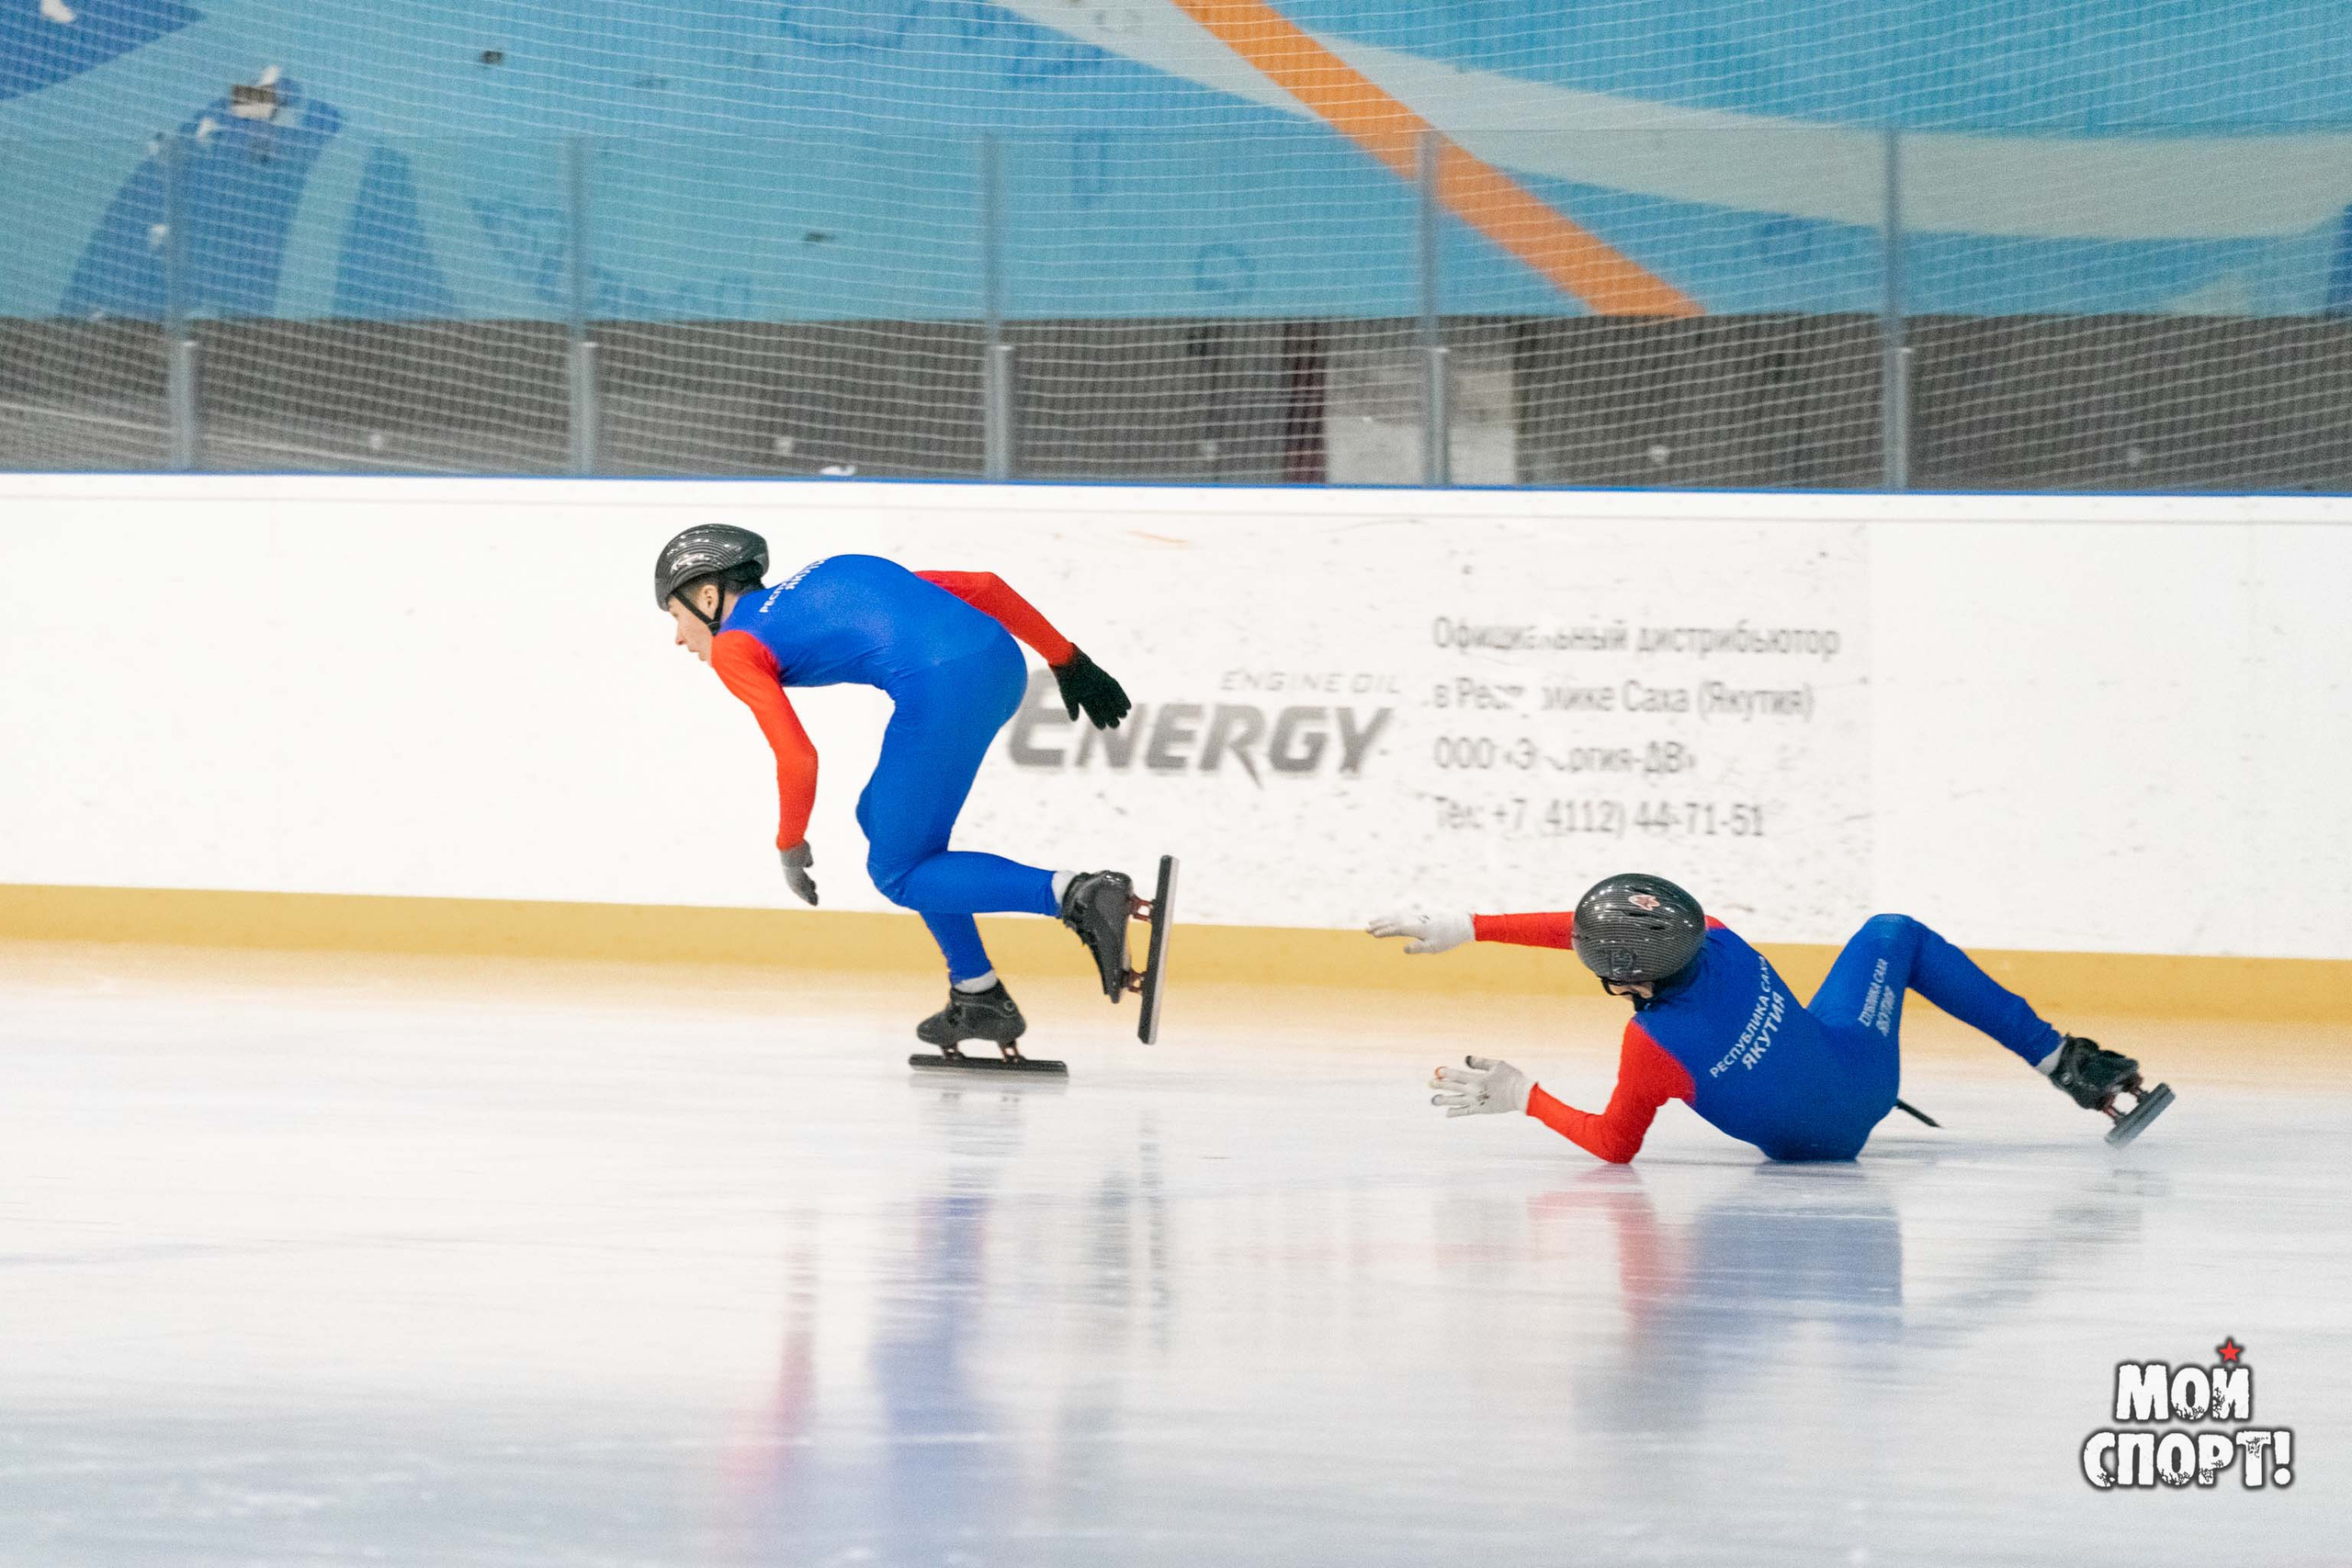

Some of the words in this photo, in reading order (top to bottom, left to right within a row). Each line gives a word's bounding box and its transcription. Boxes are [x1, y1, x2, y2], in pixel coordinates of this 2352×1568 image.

[1637, 619, 1842, 662] дистрибьютор
[1219, 669, 1344, 694] ENGINE
[1350, 671, 1401, 695] OIL
[1433, 684, 1450, 711] в
[1454, 676, 1615, 713] Ресике
[1621, 678, 1689, 714] Саха
[1697, 680, 1815, 724] (Якутия)
[1007, 667, 1395, 790] ENERGY
[1504, 737, 1697, 777] «Эргия-ДВ»
[1492, 797, 1528, 830] +7
[1542, 798, 1627, 841] 4112)
[1634, 800, 1765, 838] 44-71-51
[1709, 994, 1771, 1078] РЕСПУБЛИКА
[1742, 990, 1786, 1071] ЯКУТИЯ
